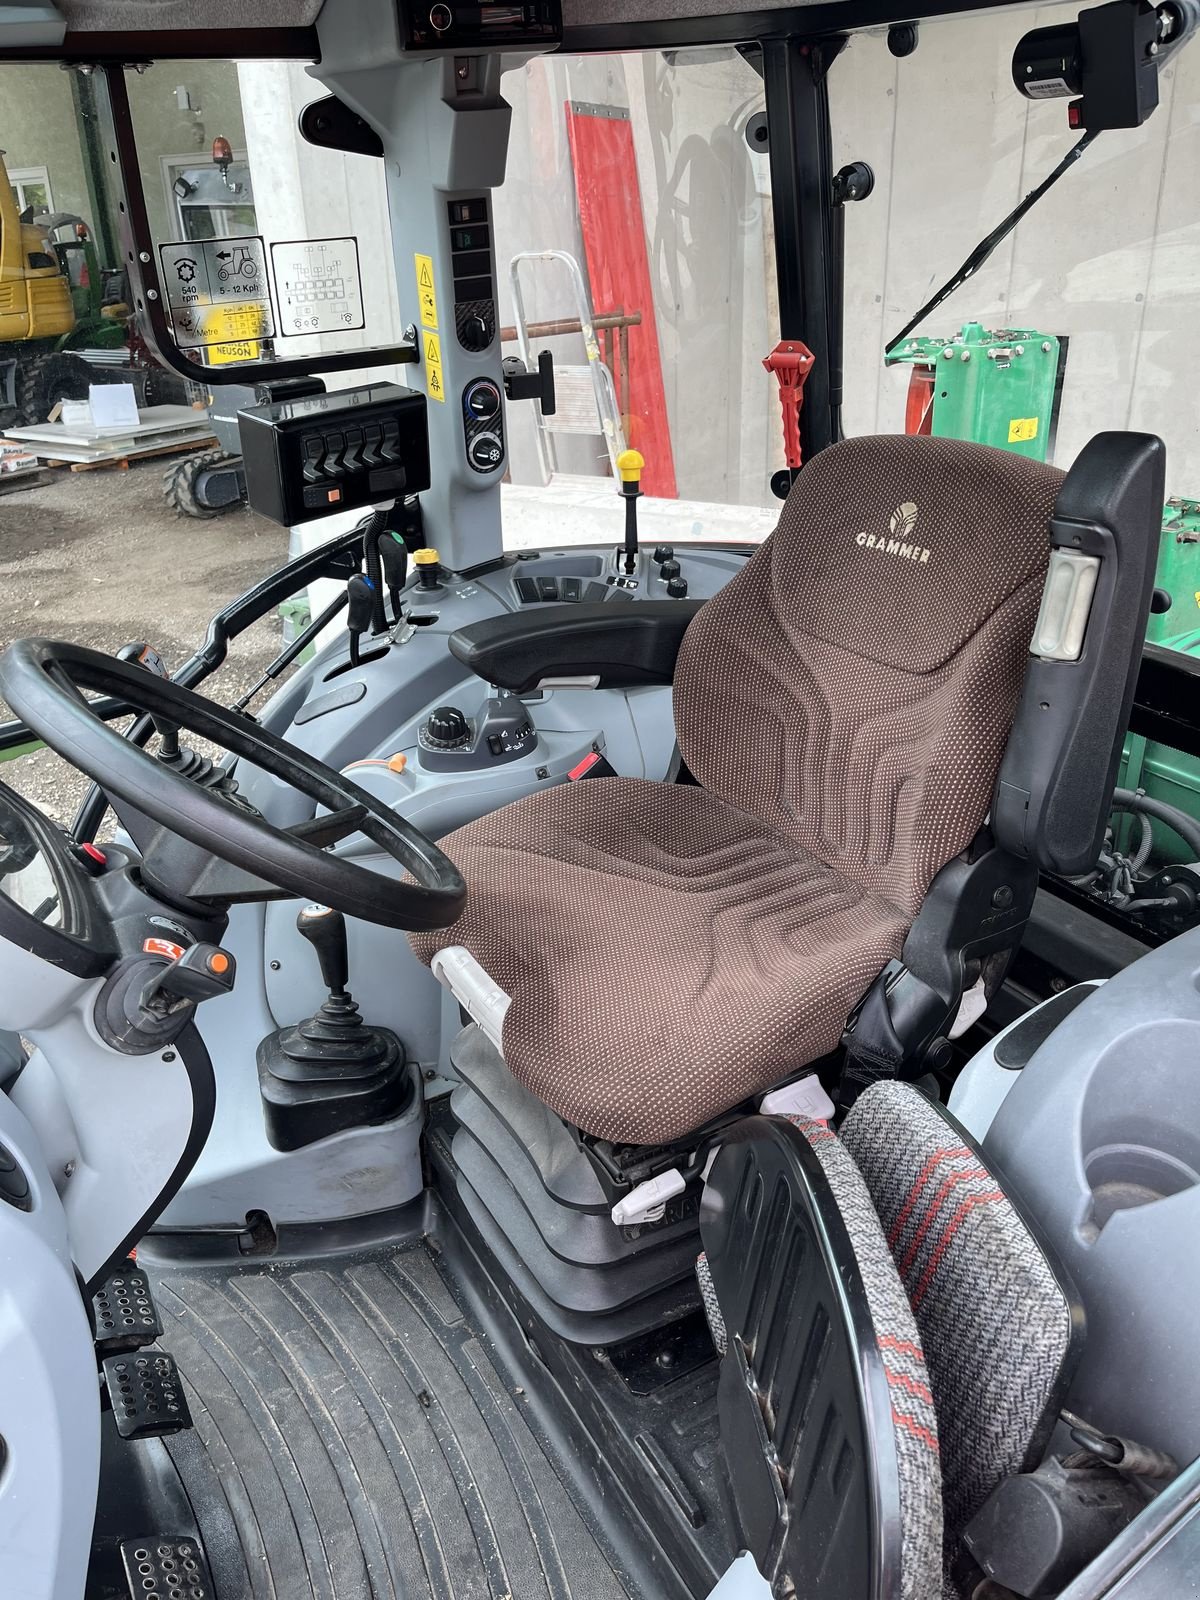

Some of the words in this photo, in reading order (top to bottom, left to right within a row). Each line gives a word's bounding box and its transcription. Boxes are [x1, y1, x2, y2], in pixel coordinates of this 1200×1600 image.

[182, 286, 196, 294] 540
[220, 287, 226, 295] 5
[233, 285, 242, 293] 12
[243, 284, 259, 294] Kph
[182, 294, 199, 303] rpm
[196, 328, 219, 337] Metre
[216, 345, 251, 356] NEUSON
[856, 532, 931, 563] GRAMMER
